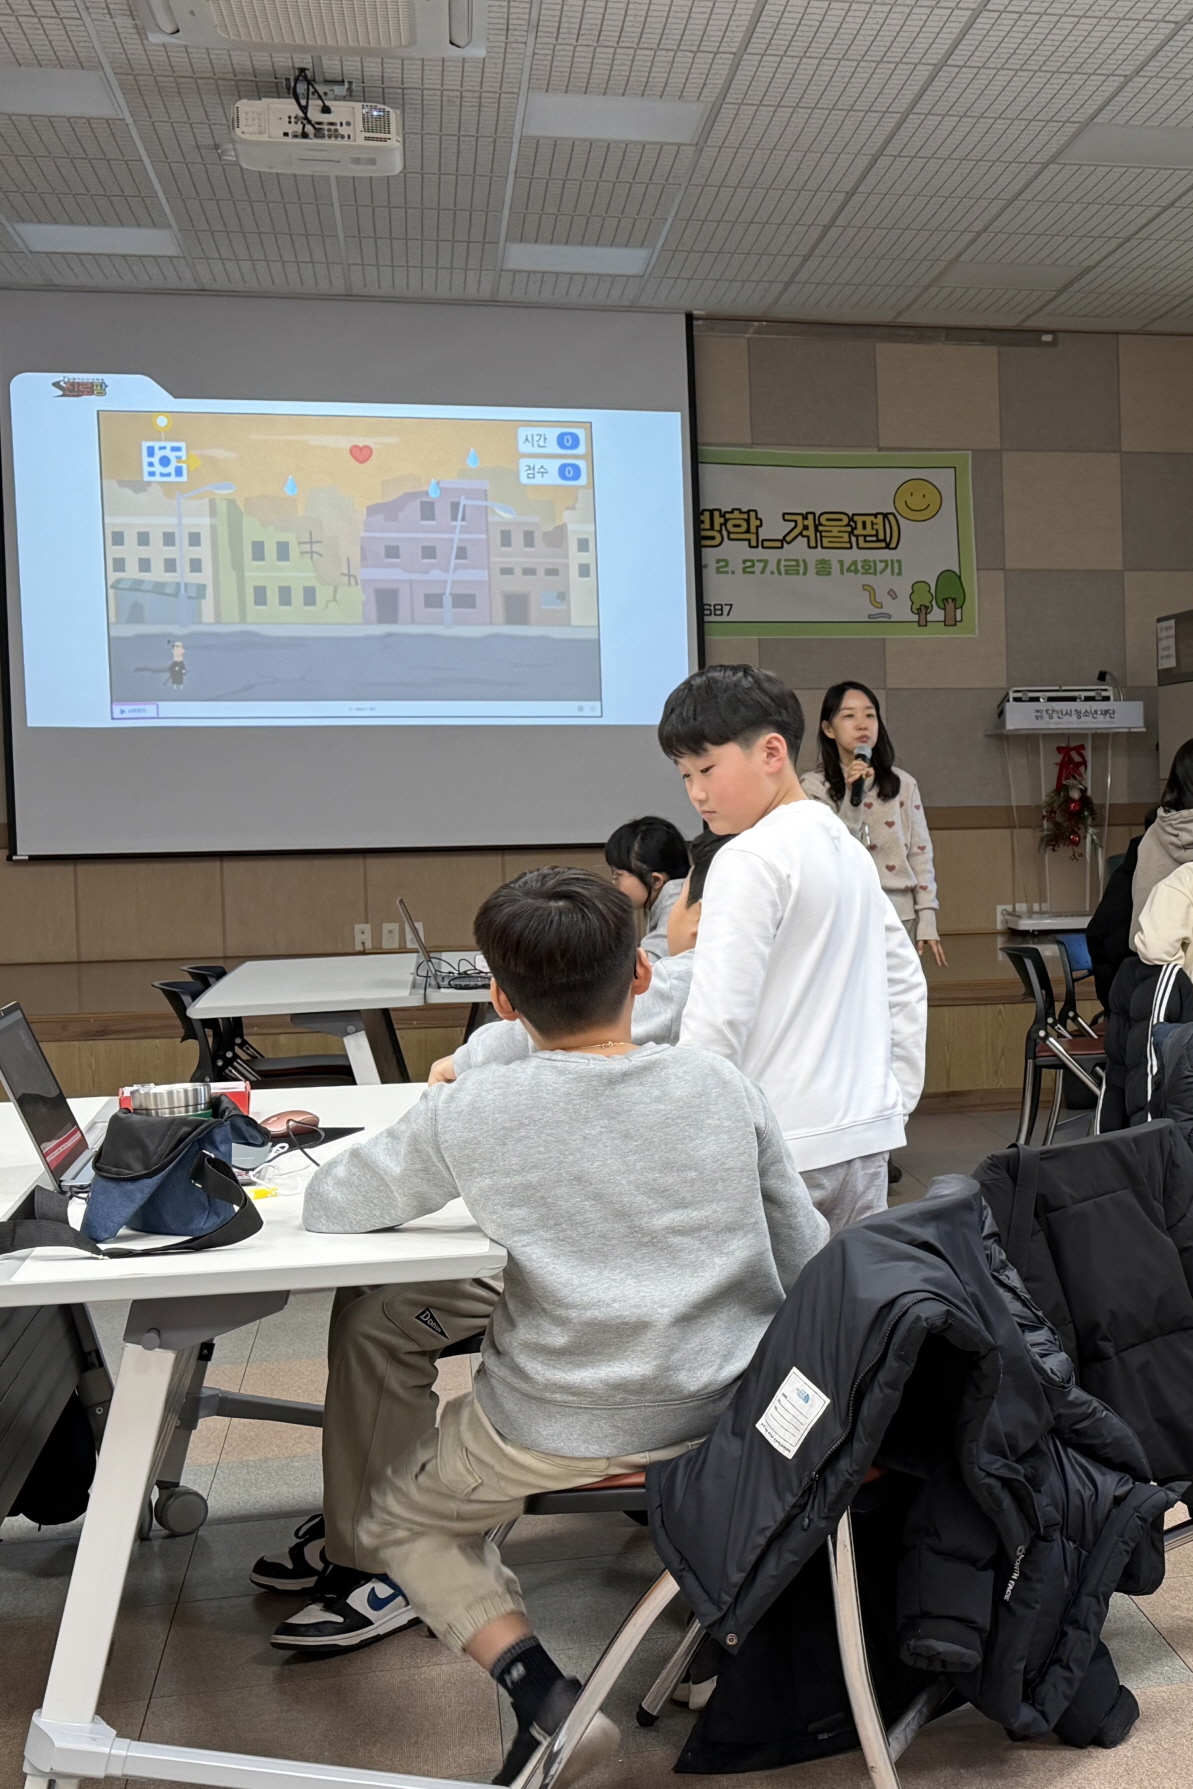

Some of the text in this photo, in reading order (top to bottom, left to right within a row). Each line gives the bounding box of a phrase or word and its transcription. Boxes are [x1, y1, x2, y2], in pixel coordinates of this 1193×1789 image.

[523, 432, 573, 449] 시간 0
[524, 464, 574, 480] 점수 0
[701, 508, 901, 550] 방학_겨울편)
[715, 558, 903, 577] 2. 27.(금) 총 14회기]
[1003, 1580, 1016, 1602] FACE
